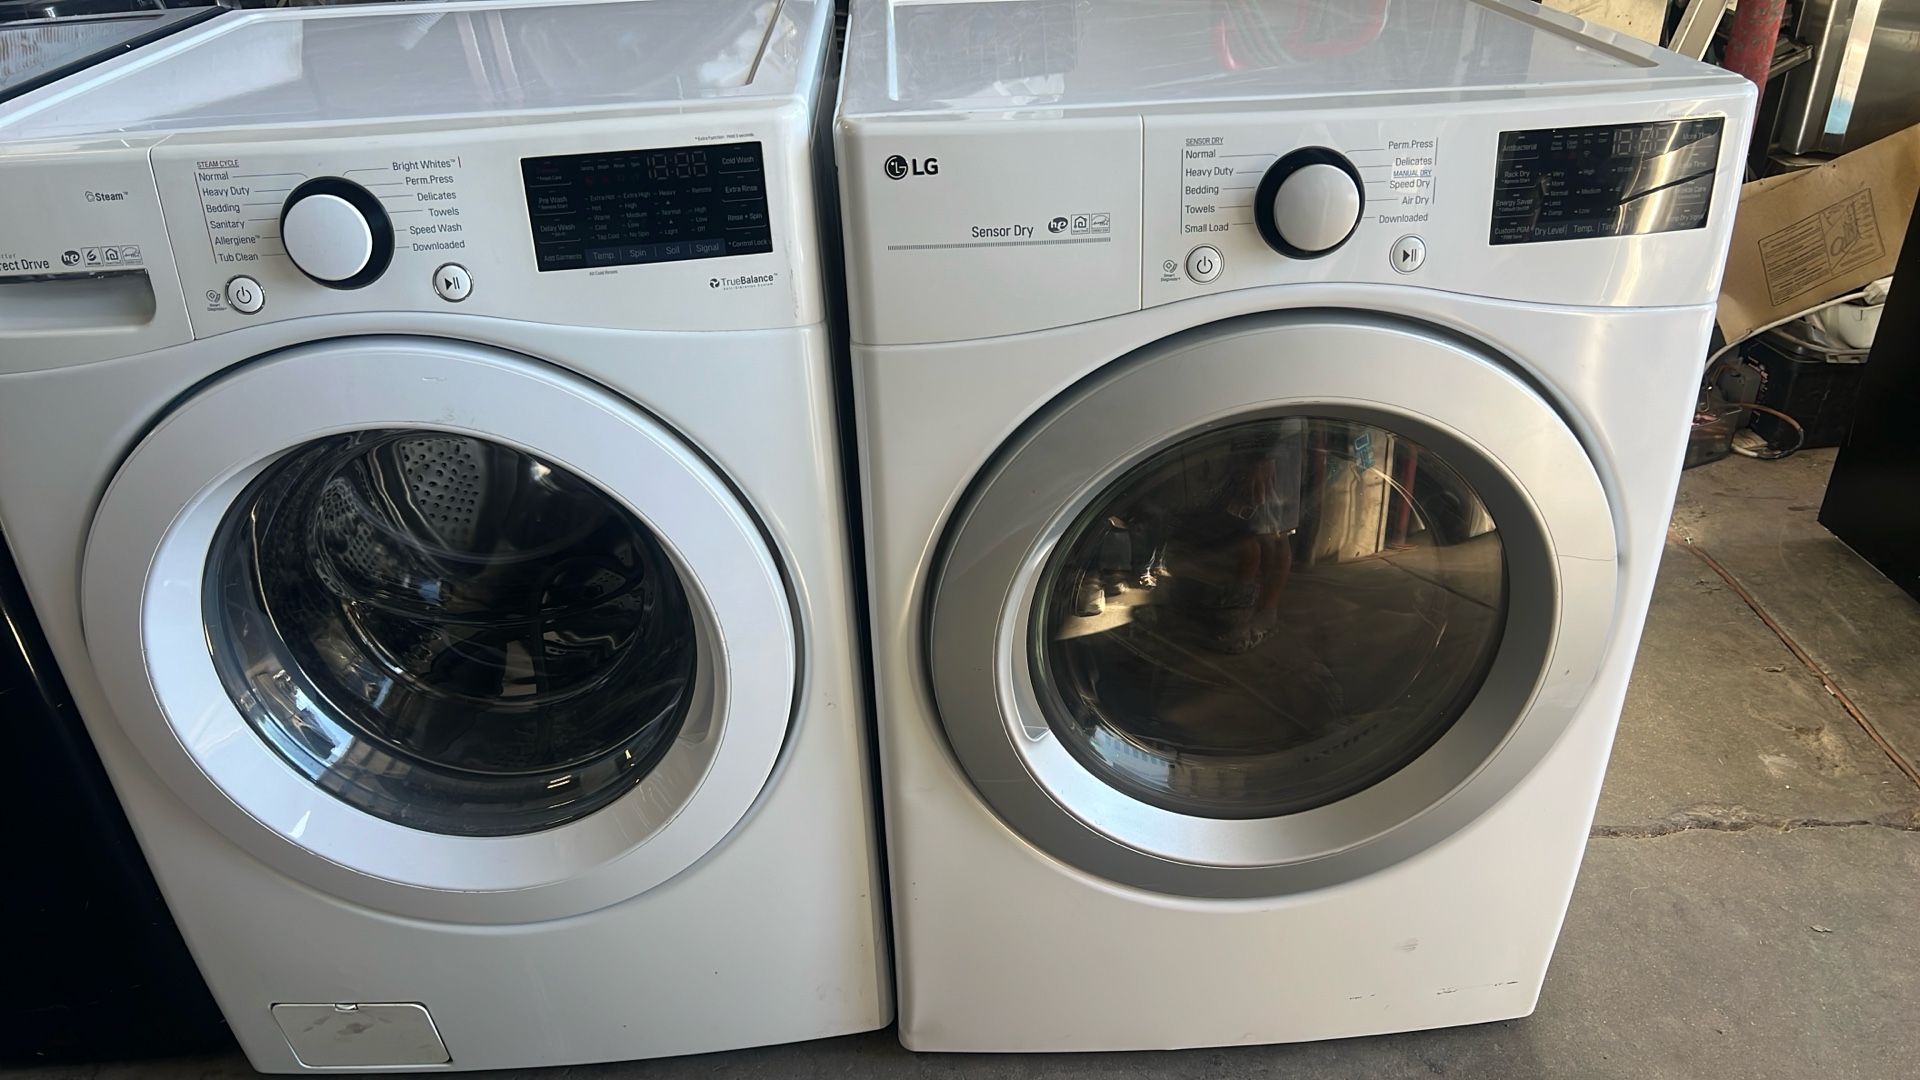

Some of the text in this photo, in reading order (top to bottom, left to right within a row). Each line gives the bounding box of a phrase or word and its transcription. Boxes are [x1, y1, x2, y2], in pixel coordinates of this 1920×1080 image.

[1186, 138, 1211, 146] SENSOR
[1185, 149, 1216, 159] Normal
[197, 159, 239, 168] STEAM CYCLE
[392, 160, 419, 172] Bright
[721, 157, 736, 165] Cold
[912, 157, 939, 175] LG
[1395, 157, 1433, 167] Delicates
[198, 171, 229, 181] Normal
[1185, 166, 1234, 177] Heavy Duty
[1393, 169, 1432, 177] MANUAL DRY
[1519, 170, 1530, 178] Dry
[725, 184, 758, 194] Extra Rinse
[1390, 178, 1430, 190] Speed Dry
[202, 186, 250, 197] Heavy Duty
[1185, 185, 1219, 195] Bedding
[417, 191, 457, 202] Delicates
[1402, 195, 1429, 205] Air Dry
[205, 203, 240, 213] Bedding
[1185, 204, 1216, 214] Towels
[1495, 200, 1516, 208] Energy
[428, 206, 460, 217] Towels
[749, 213, 763, 221] Spin
[1379, 213, 1428, 224] Downloaded
[210, 220, 245, 229] Sanitary
[409, 223, 463, 235] Speed Wash
[558, 223, 576, 231] Wash
[1185, 222, 1229, 233] Small Load
[971, 224, 1034, 239] Sensor Dry
[1534, 227, 1548, 236] Dry
[412, 240, 466, 252] Downloaded
[665, 246, 680, 255] Soil
[695, 243, 719, 253] Signal
[217, 252, 259, 262] Tub Clean
[630, 250, 647, 258] Spin
[21, 259, 50, 271] Drive
